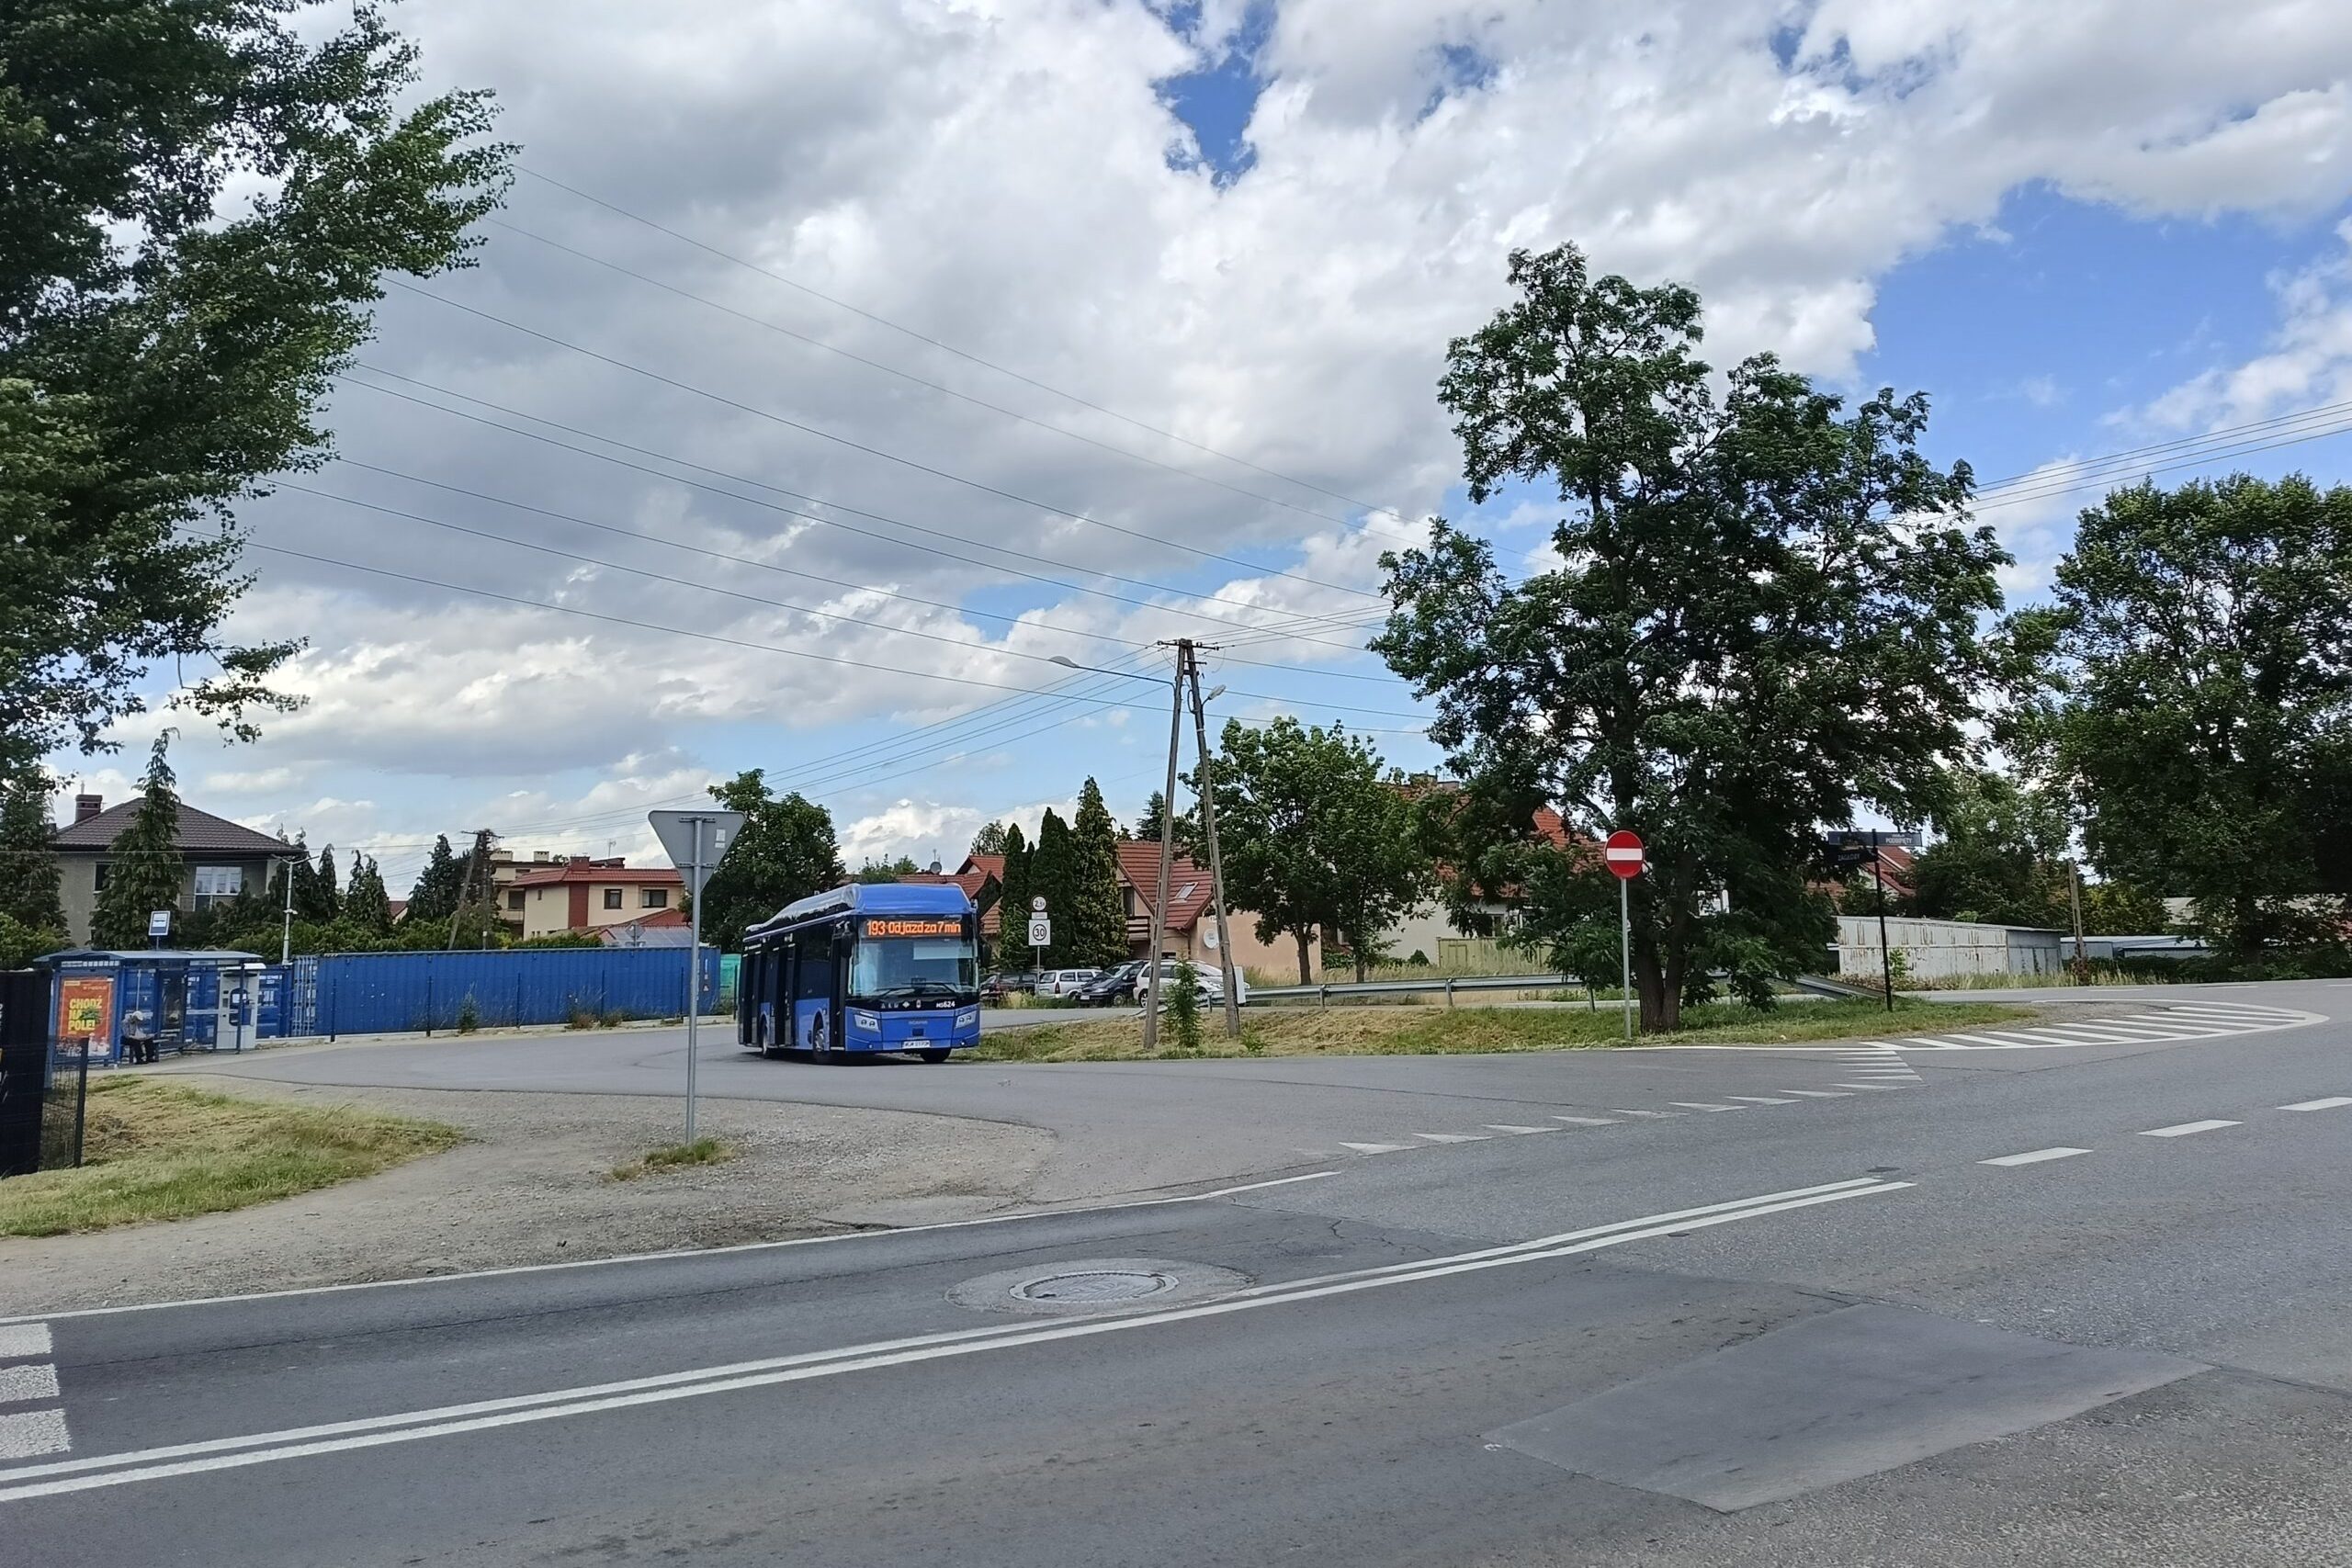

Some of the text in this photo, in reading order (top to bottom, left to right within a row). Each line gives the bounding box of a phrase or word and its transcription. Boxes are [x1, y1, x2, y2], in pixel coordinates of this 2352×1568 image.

[866, 919, 961, 936] 193 Odjazd za 7 min
[1035, 928, 1046, 937] 30
[69, 995, 103, 1010] CHODŹ
[68, 1020, 96, 1031] POLE!
